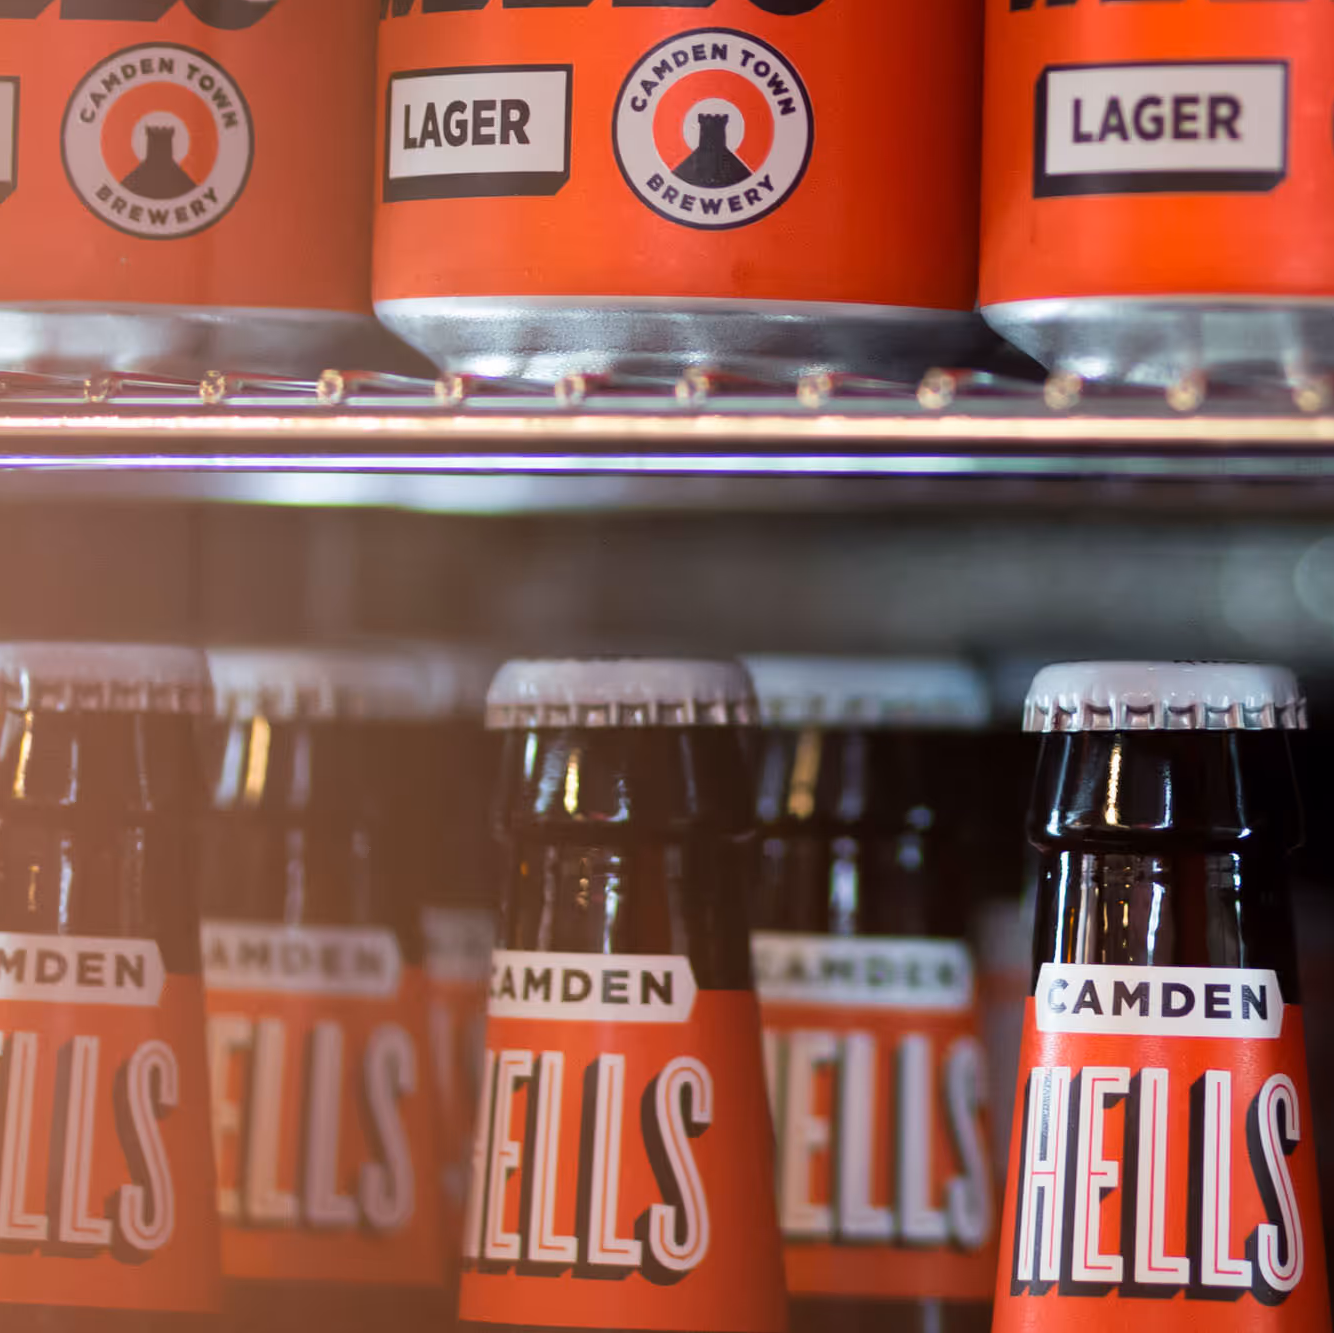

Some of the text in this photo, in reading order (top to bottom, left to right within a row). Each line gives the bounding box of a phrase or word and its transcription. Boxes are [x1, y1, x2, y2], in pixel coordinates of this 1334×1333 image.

[79, 57, 239, 130] CAMDEN TOWN
[630, 43, 797, 116] CAMDEN TOWN
[402, 98, 532, 151] LAGER
[1071, 95, 1243, 145] LAGER
[95, 184, 219, 225] BREWERY
[646, 173, 775, 216] BREWERY
[489, 965, 674, 1006] AMDEN
[1045, 977, 1269, 1021] CAMDEN
[1010, 1066, 1305, 1306] HELLS
